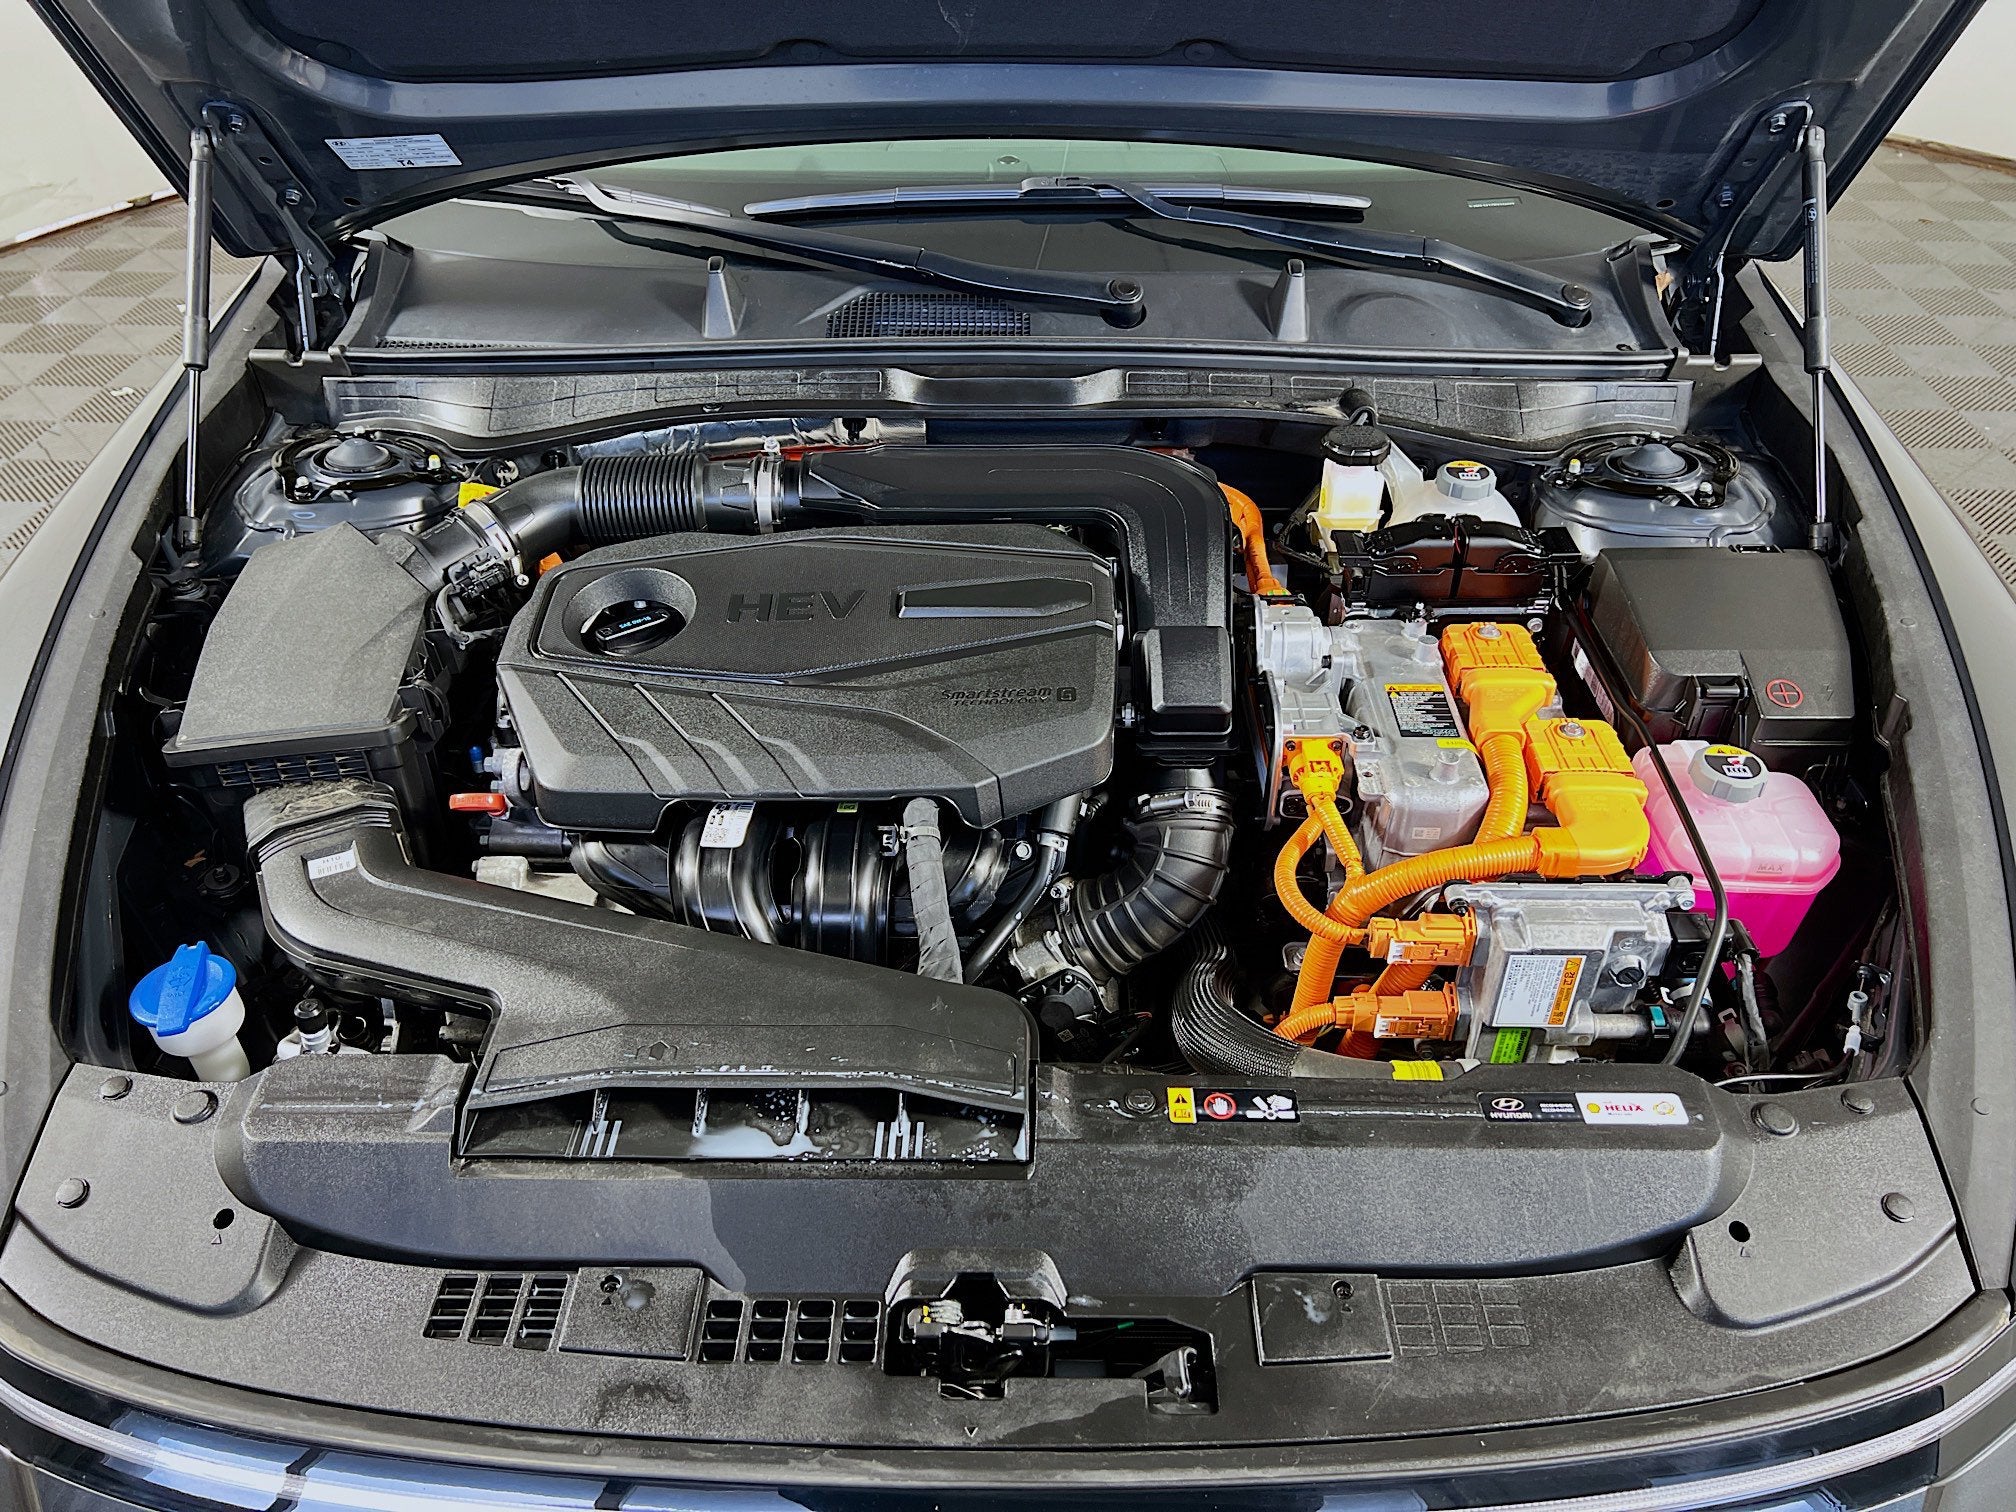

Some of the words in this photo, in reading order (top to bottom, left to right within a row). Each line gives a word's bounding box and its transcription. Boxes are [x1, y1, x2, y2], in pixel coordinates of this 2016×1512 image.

[725, 589, 867, 624] HEV
[940, 687, 1052, 700] Smartstream
[1604, 1104, 1645, 1112] HELIX
[1489, 1111, 1533, 1119] HYUNDAI
